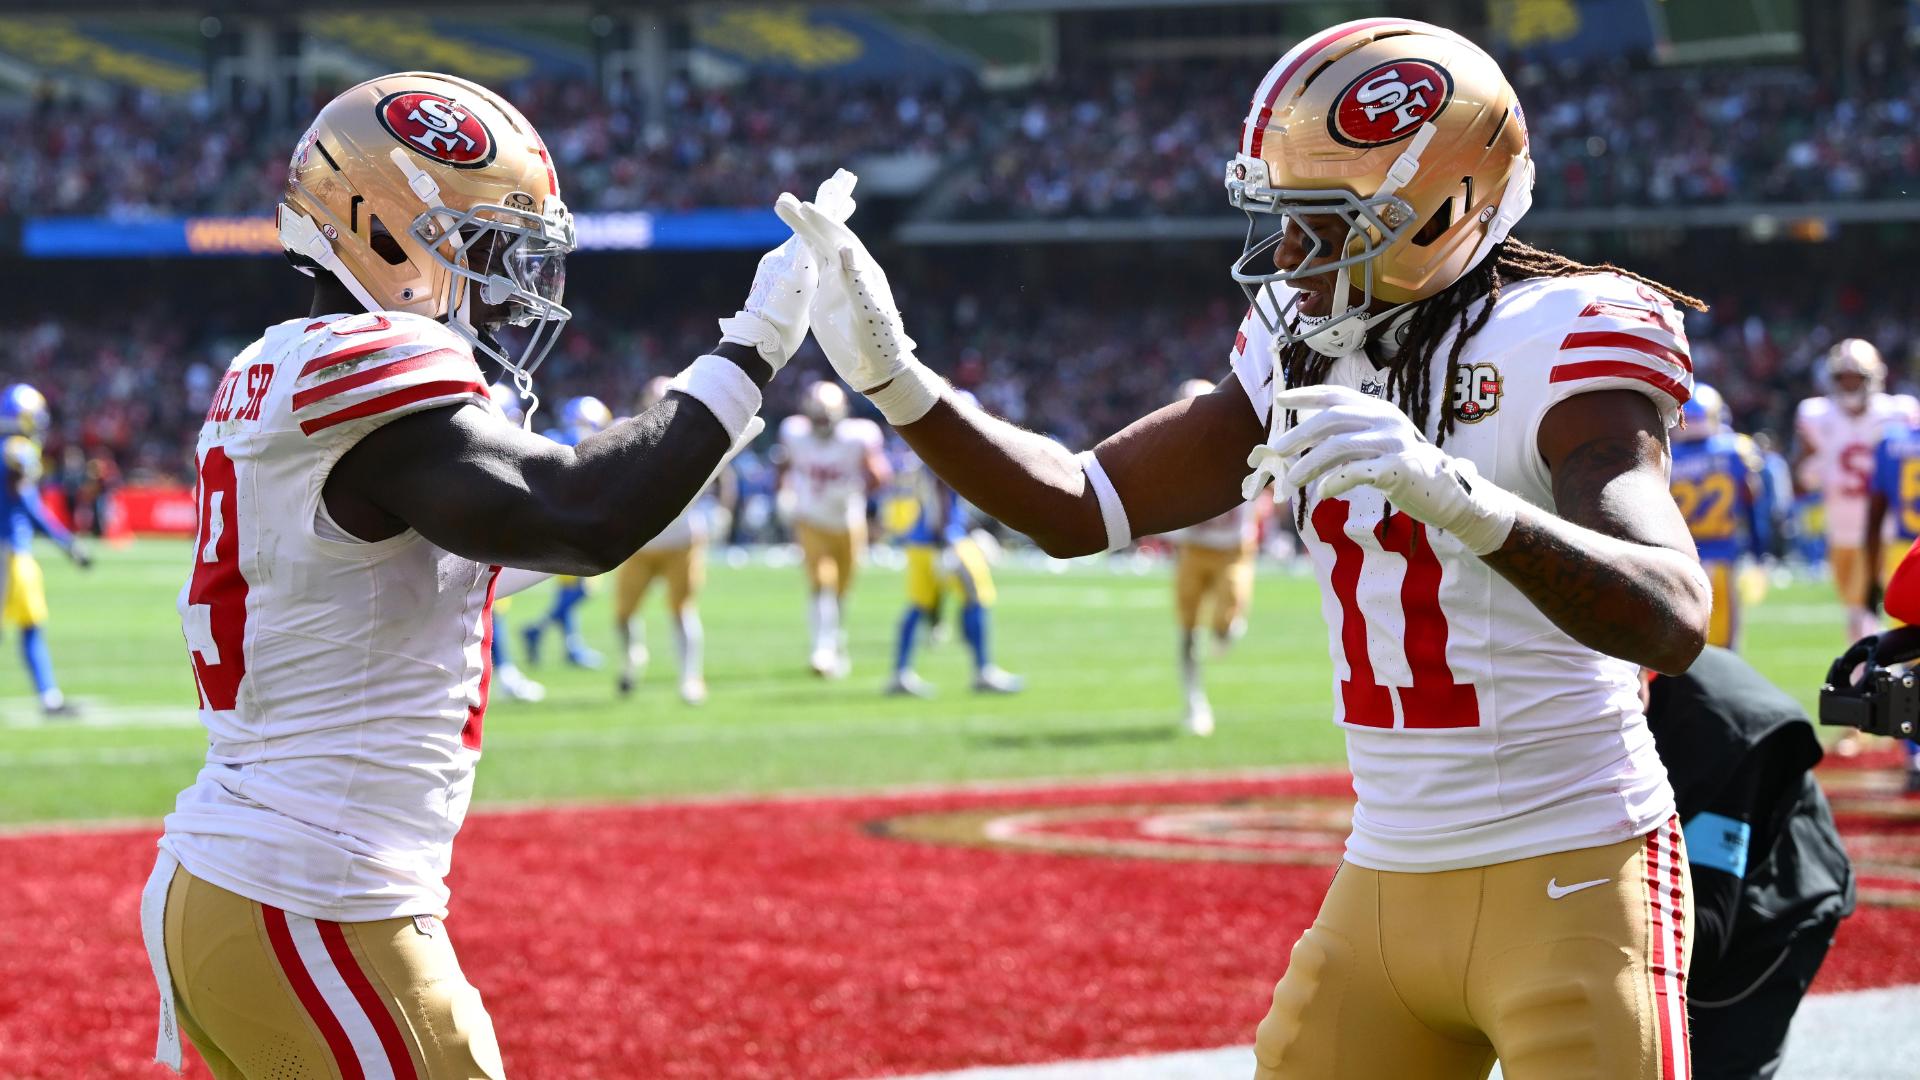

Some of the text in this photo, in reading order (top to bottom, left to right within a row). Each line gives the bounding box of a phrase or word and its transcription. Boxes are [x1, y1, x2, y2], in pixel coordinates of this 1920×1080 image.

[407, 98, 477, 153] SF
[1356, 68, 1435, 134] SF
[234, 364, 274, 421] SR
[188, 445, 250, 711] 9
[1311, 497, 1480, 729] 11
